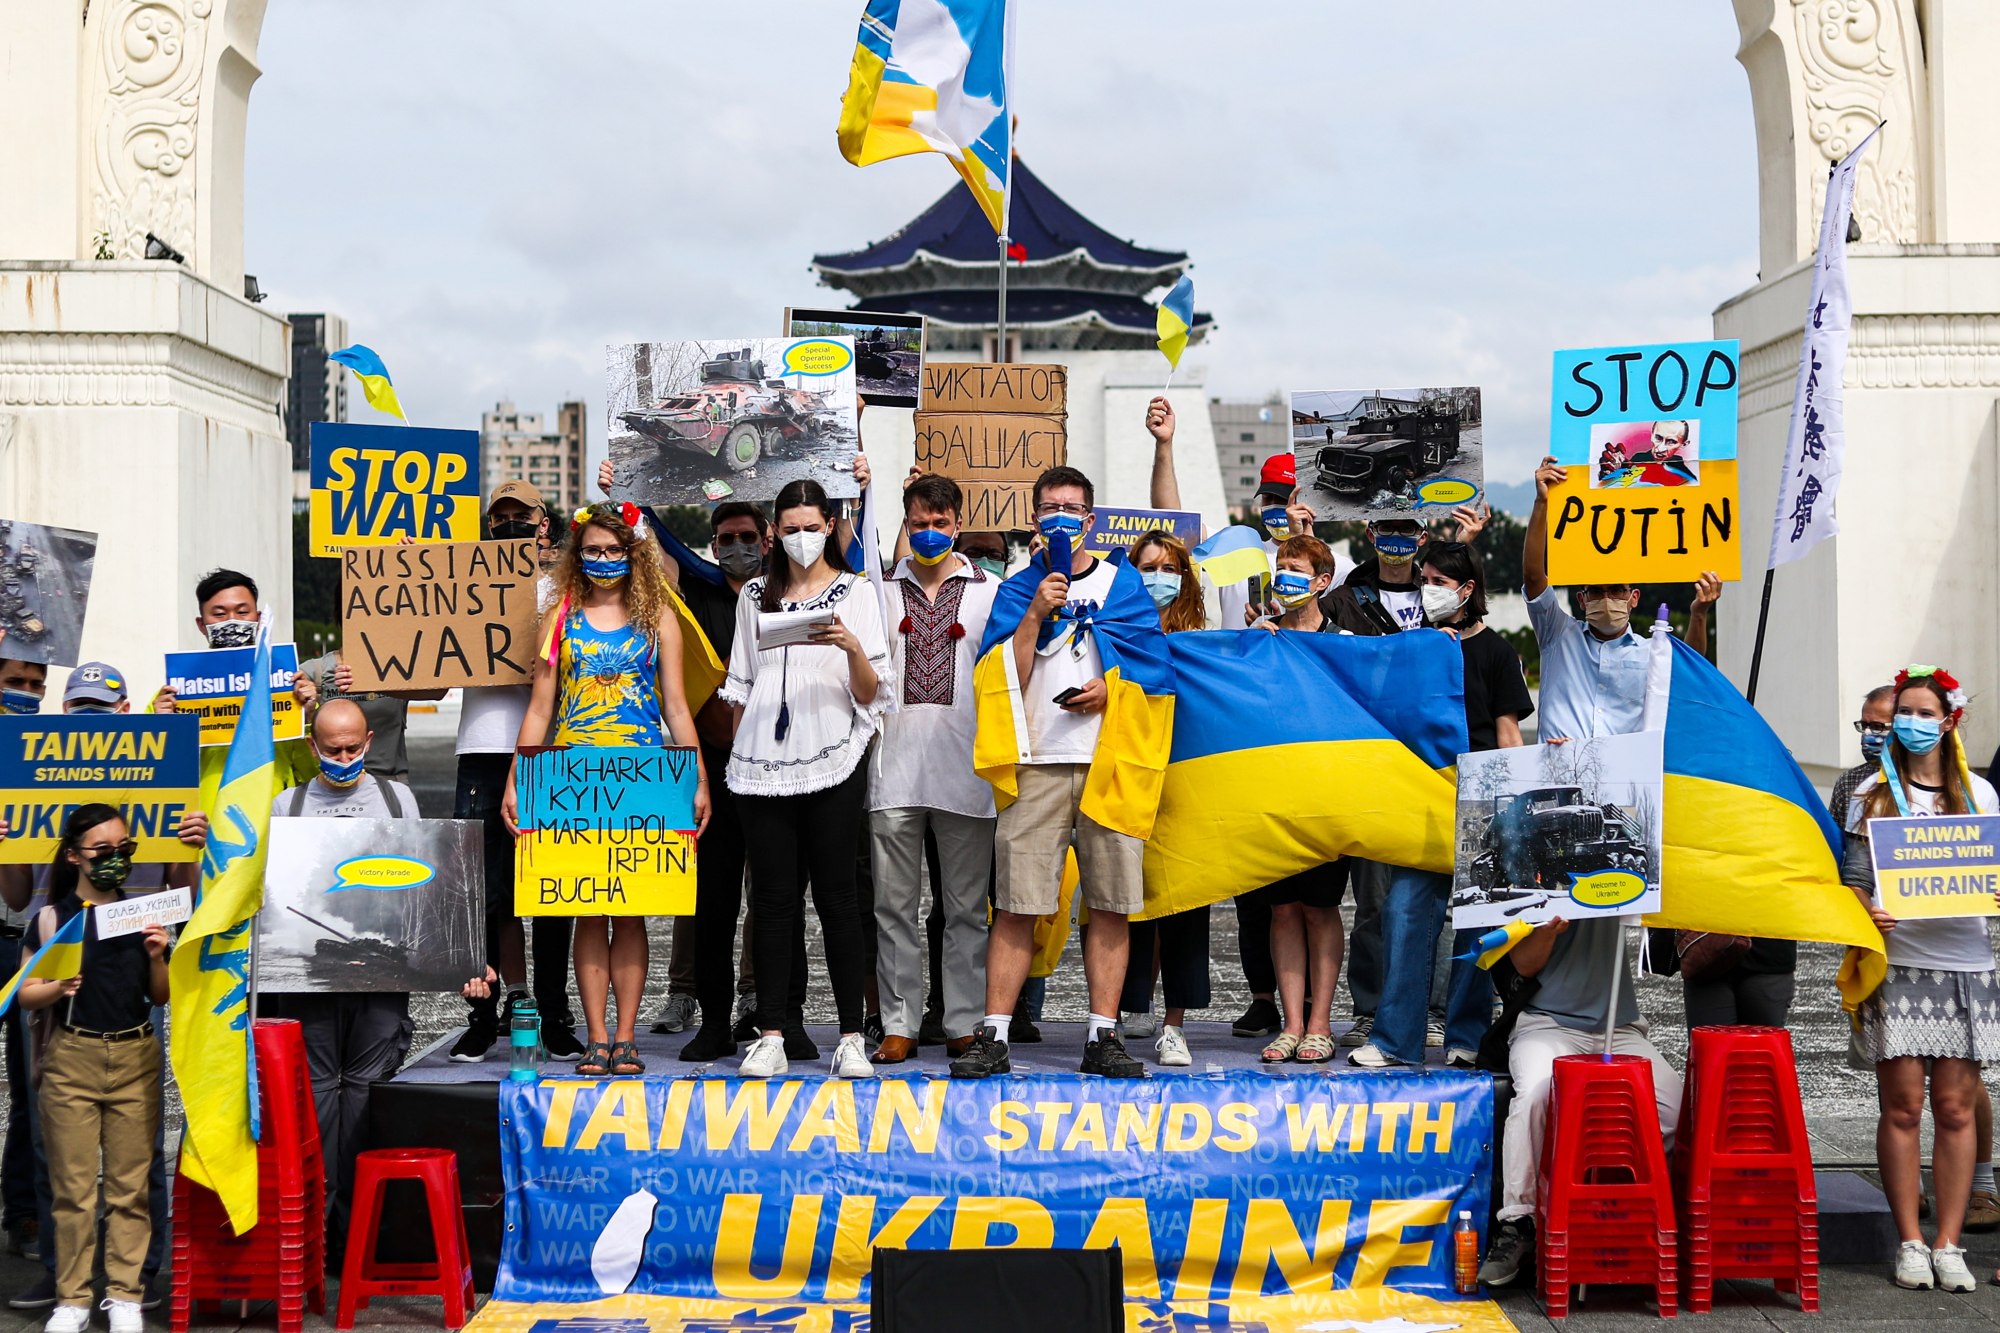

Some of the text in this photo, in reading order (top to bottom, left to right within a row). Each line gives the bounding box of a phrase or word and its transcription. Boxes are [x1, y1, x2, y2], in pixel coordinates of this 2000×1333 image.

[1564, 350, 1737, 417] STOP
[915, 424, 1063, 471] ФАШИСТ
[326, 446, 468, 495] STOP
[330, 489, 456, 540] WAR
[1108, 516, 1175, 533] TAIWAN
[1095, 533, 1138, 546] STAND
[346, 543, 536, 580] RUSSIANS
[346, 582, 516, 619] AGAINST
[361, 623, 527, 682] WAR
[169, 677, 226, 695] Matsu
[212, 704, 241, 717] with
[21, 732, 168, 761] TAIWAN
[34, 767, 155, 781] STANDS WITH
[567, 756, 687, 784] KHARKIV
[317, 807, 339, 815] THIS
[550, 785, 625, 813] KYIV
[538, 814, 679, 845] MARIUPOL
[1904, 825, 1980, 844] TAIWAN
[608, 847, 686, 874] IRPIN
[1893, 844, 1994, 861] STANDS WITH
[359, 869, 384, 877] Victory
[1590, 881, 1618, 889] Welcome
[1899, 874, 1998, 898] UKRAINE
[539, 876, 627, 905] BUCHA
[1596, 890, 1620, 898] Ukraine
[107, 903, 142, 919] СЛАВА
[538, 1080, 949, 1153] TAIWAN
[983, 1100, 1259, 1152] STANDS
[1285, 1102, 1455, 1153] WITH
[687, 1168, 759, 1194] WAR
[780, 1170, 829, 1196] NO
[931, 1172, 978, 1197] NO
[986, 1173, 1059, 1199] WAR
[1232, 1174, 1279, 1199] NO
[1288, 1174, 1360, 1201] WAR
[710, 1193, 1451, 1298] UKRAINE
